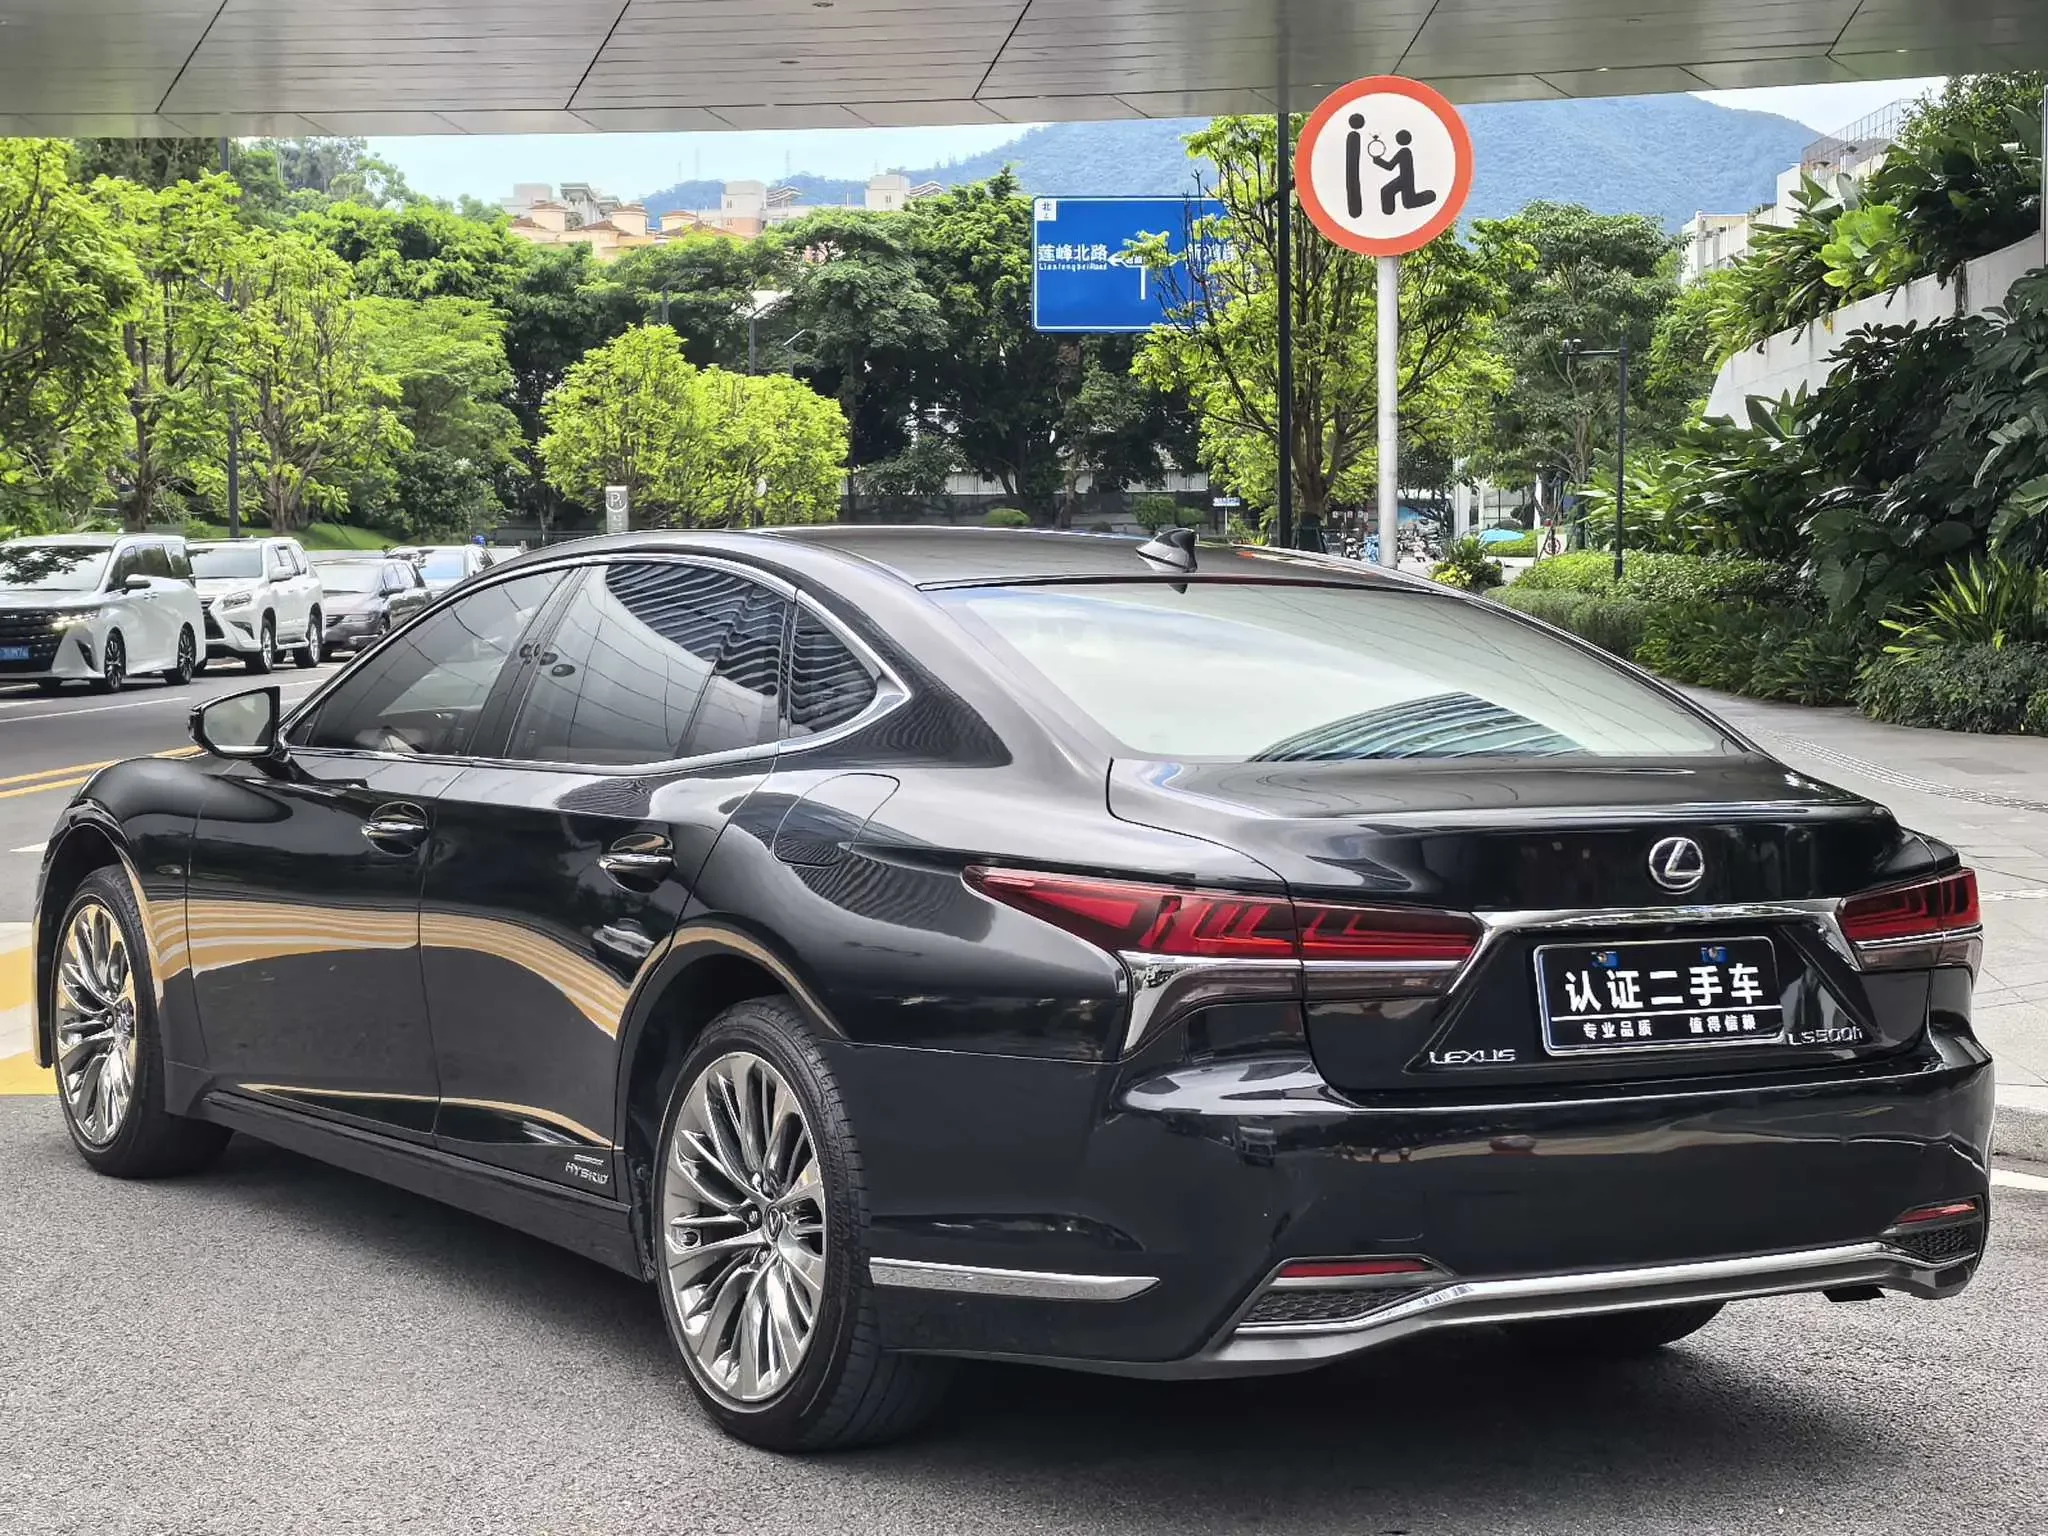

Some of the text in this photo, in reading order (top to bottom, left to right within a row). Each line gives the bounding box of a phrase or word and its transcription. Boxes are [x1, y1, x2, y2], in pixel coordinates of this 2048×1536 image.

[1565, 963, 1764, 1012] 认证二手车
[1583, 1014, 1756, 1040] 专业品质 值得信赖
[1429, 1049, 1516, 1064] LEXUS
